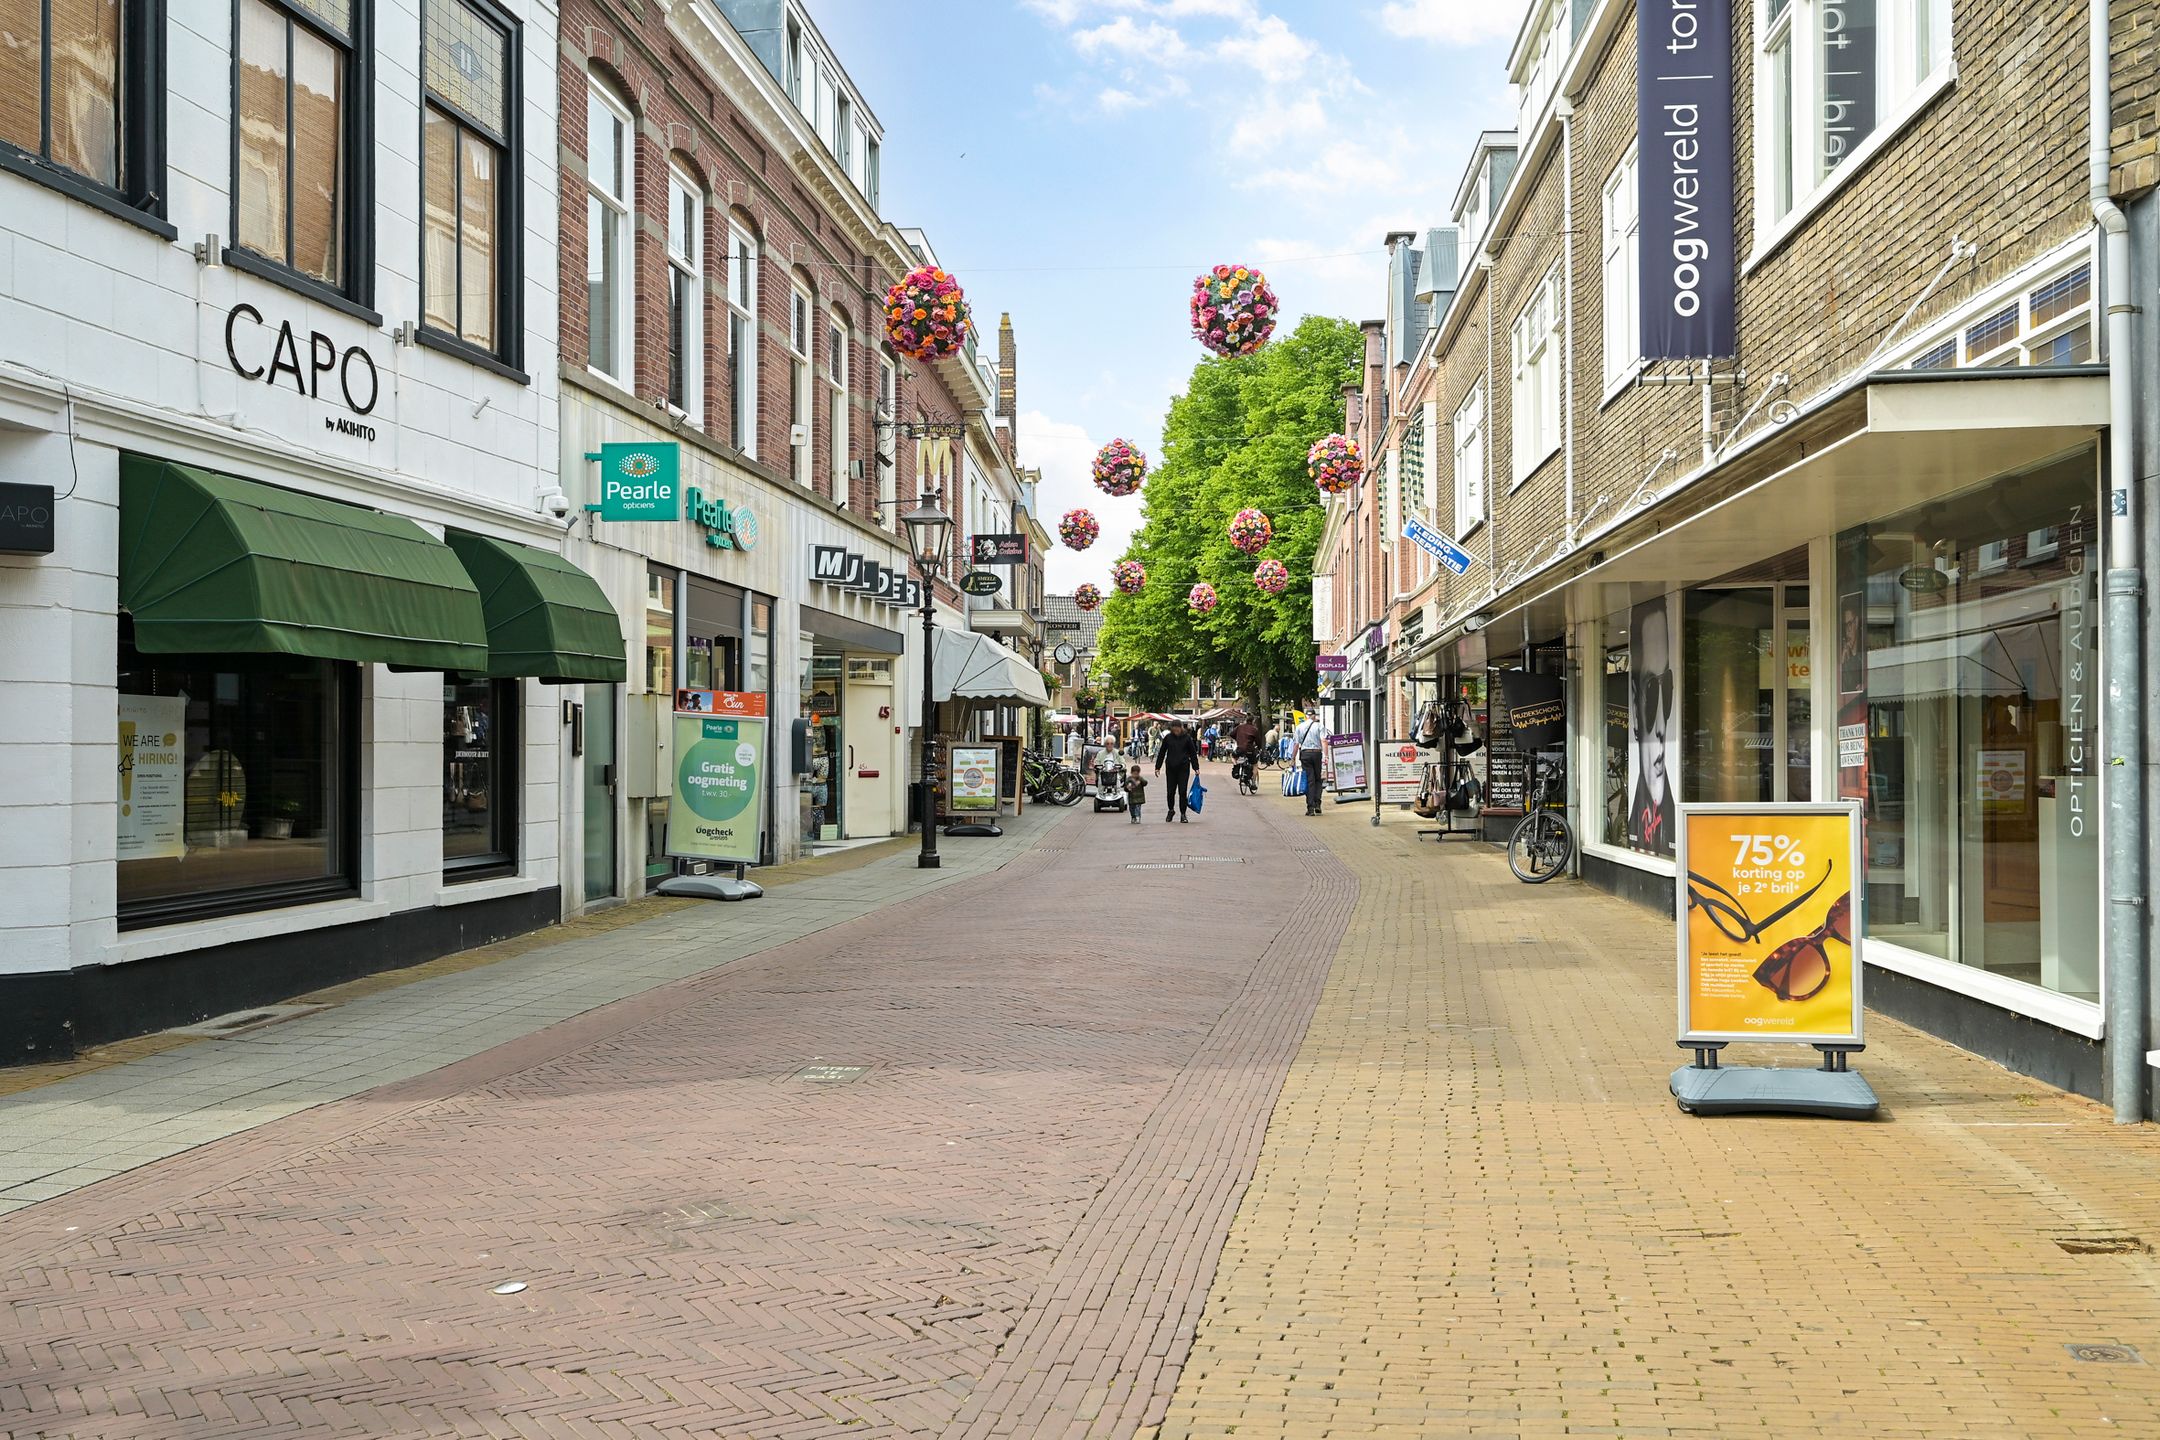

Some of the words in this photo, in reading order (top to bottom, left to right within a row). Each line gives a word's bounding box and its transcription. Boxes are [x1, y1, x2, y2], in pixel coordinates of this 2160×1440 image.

[1664, 104, 1708, 317] oogwereld
[225, 303, 378, 415] CAPO
[326, 417, 335, 432] by
[336, 418, 376, 442] AKIHITO
[930, 426, 960, 434] MULDER
[917, 437, 950, 475] M
[607, 481, 671, 500] Pearle
[623, 502, 655, 511] opticiens
[688, 487, 735, 534] Pearle
[710, 534, 733, 550] opticiens
[1410, 522, 1454, 555] KLEDING-
[1412, 533, 1463, 572] REPARATIE
[2070, 503, 2083, 650] AUDICIEN
[2070, 661, 2083, 683] &
[1513, 706, 1560, 720] MUZIEKSCHOOL
[122, 735, 139, 747] WE
[141, 735, 160, 747] ARE
[138, 753, 178, 765] HIRING!
[701, 762, 735, 774] Gratis
[2070, 694, 2083, 837] OPTICIEN
[688, 776, 747, 791] oogmeting
[1730, 834, 1806, 866] 75%
[1732, 867, 1782, 881] korting
[1786, 869, 1805, 881] op
[1737, 882, 1751, 896] je
[1744, 1016, 1795, 1026] oogwereld
